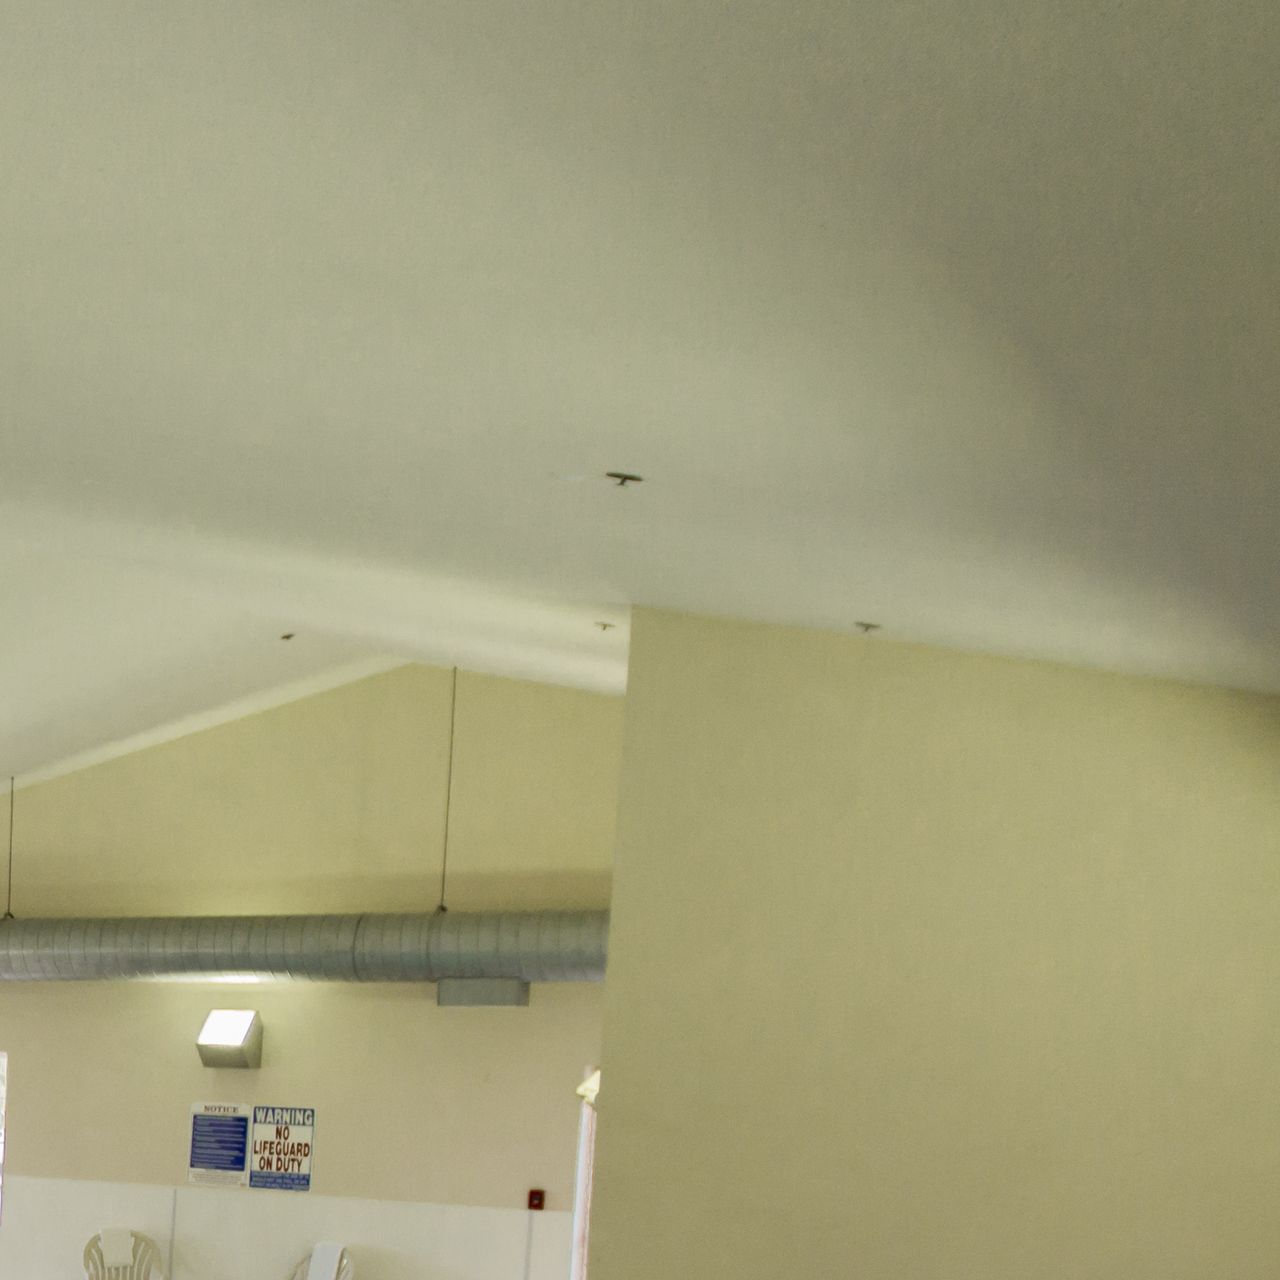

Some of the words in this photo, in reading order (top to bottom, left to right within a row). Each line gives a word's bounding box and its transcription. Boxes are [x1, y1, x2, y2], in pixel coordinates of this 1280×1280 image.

[203, 1104, 239, 1114] NOTICE
[255, 1108, 313, 1126] WARNING
[275, 1125, 290, 1140] NO
[253, 1140, 310, 1158] LIFEGUARD
[258, 1156, 273, 1171] ON
[275, 1157, 303, 1173] DUTY
